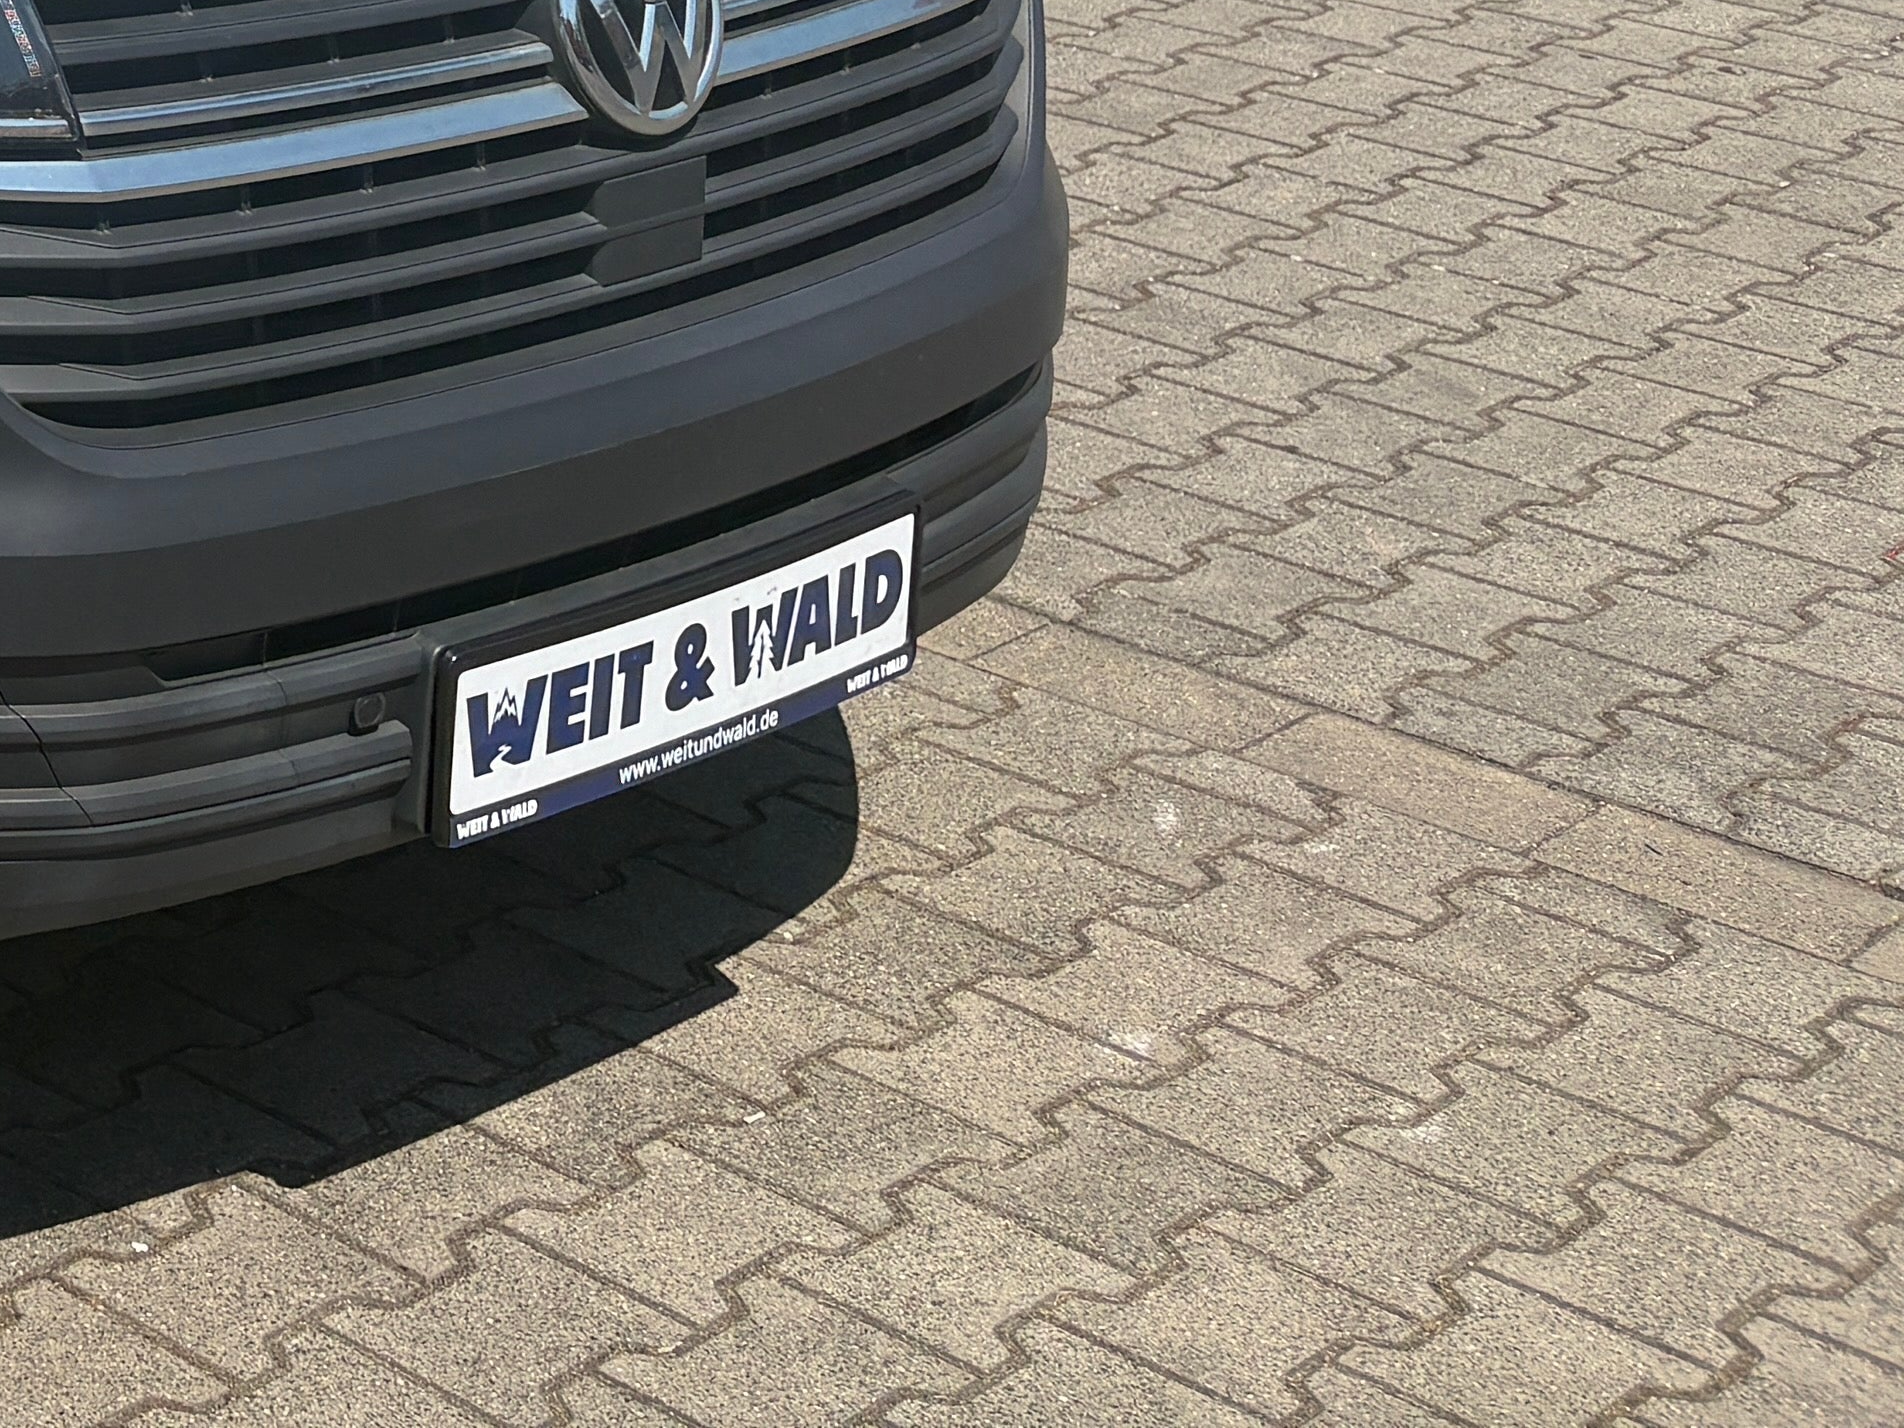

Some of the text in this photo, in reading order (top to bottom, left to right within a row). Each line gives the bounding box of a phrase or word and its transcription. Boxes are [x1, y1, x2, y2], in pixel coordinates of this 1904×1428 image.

[465, 548, 904, 778] WEIT & WALD
[618, 707, 779, 785] www.weitundwald.de
[456, 815, 489, 840] WEIT
